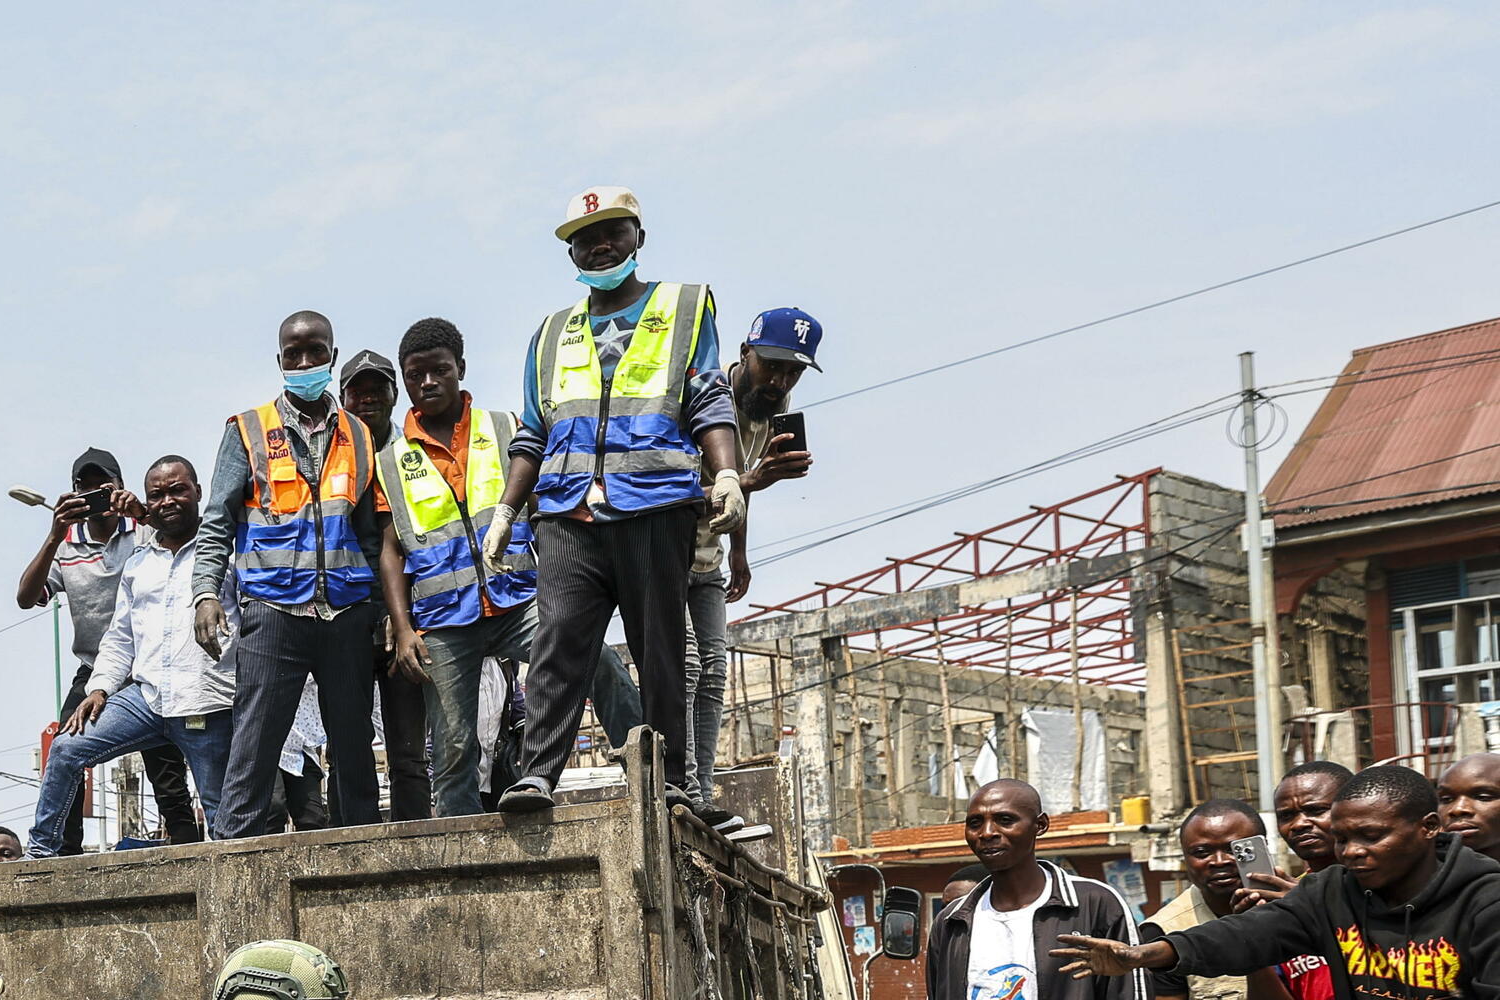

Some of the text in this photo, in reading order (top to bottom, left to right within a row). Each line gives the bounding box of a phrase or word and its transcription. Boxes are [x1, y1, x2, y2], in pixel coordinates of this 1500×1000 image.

[582, 193, 599, 215] B
[267, 448, 289, 460] AAGD
[404, 468, 428, 482] AAGD
